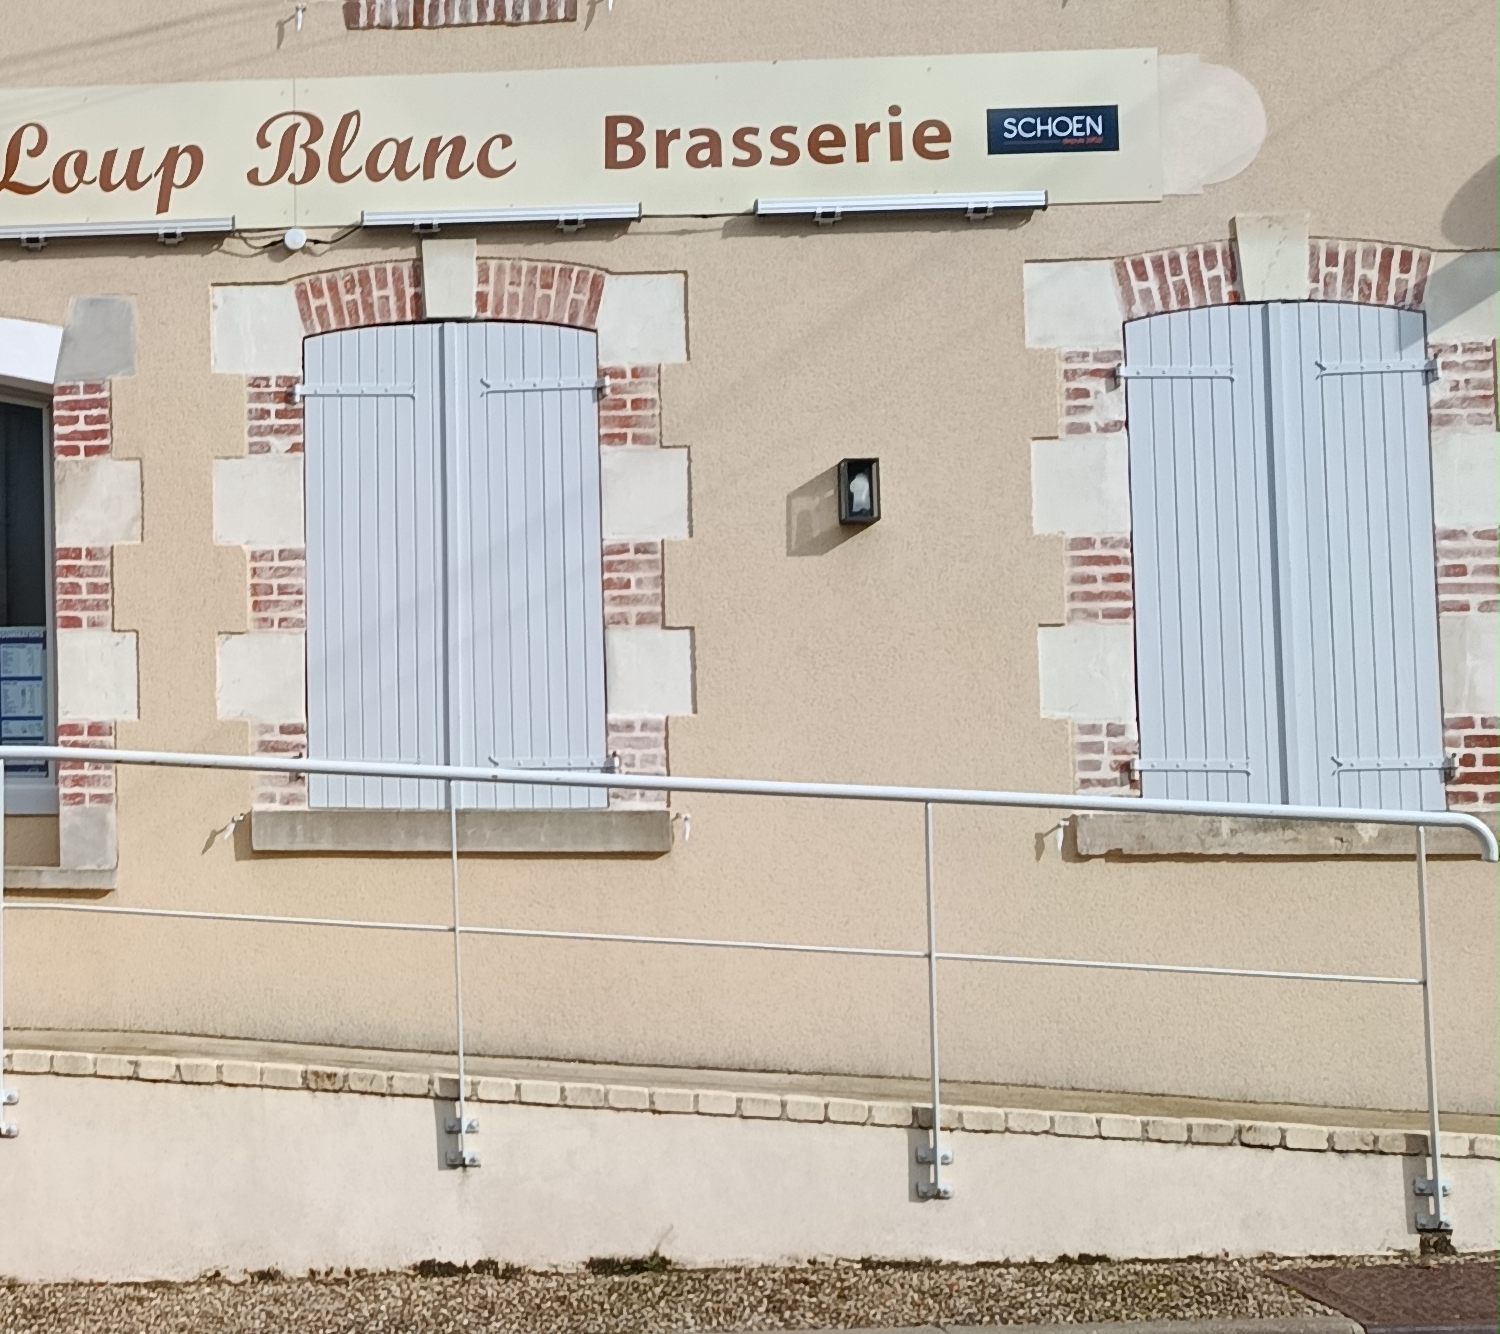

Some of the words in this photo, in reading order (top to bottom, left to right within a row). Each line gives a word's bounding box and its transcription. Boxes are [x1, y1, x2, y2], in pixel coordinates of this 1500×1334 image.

[247, 108, 518, 188] Blanc
[605, 105, 952, 169] Brasserie
[1003, 115, 1103, 138] SCHOEN
